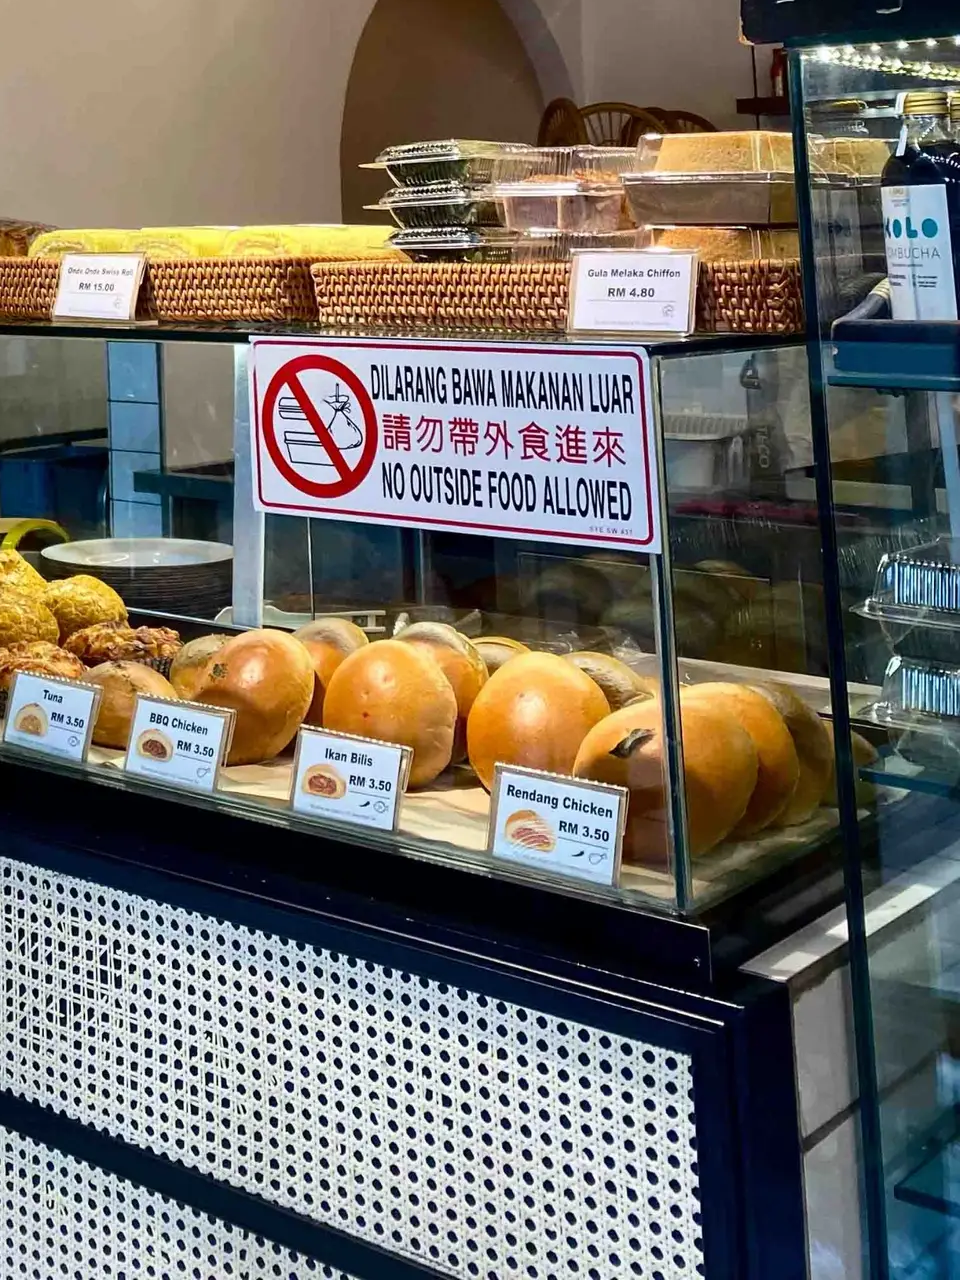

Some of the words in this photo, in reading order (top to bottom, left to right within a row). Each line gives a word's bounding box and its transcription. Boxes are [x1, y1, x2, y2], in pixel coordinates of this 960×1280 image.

[588, 269, 608, 278] Gula
[611, 269, 644, 278] Melaka
[647, 269, 680, 278] Chiffon
[608, 288, 625, 297] RM
[629, 288, 655, 297] 4.80
[370, 364, 446, 405] DILARANG
[452, 367, 497, 407] BAWA
[501, 369, 583, 411] MAKANAN
[589, 372, 634, 414] LUAR
[382, 413, 626, 468] 請勿帶外食進來
[382, 462, 405, 500] NO
[411, 465, 483, 508] OUTSIDE
[488, 470, 538, 512] FOOD
[544, 476, 632, 521] ALLOWED
[43, 690, 63, 704] Tuna
[51, 712, 64, 723] RM
[66, 715, 84, 729] 3.50
[149, 713, 169, 726] BBQ
[171, 718, 208, 735] Chicken
[177, 740, 191, 752] RM
[194, 744, 214, 758] 3.50
[325, 748, 347, 763] Ikan
[350, 752, 373, 767] Bilis
[349, 775, 365, 787] RM
[369, 779, 392, 792] 3.50
[506, 785, 559, 807] Rendang
[563, 797, 613, 818] Chicken
[558, 820, 578, 836] RM
[582, 826, 609, 842] 3.50
